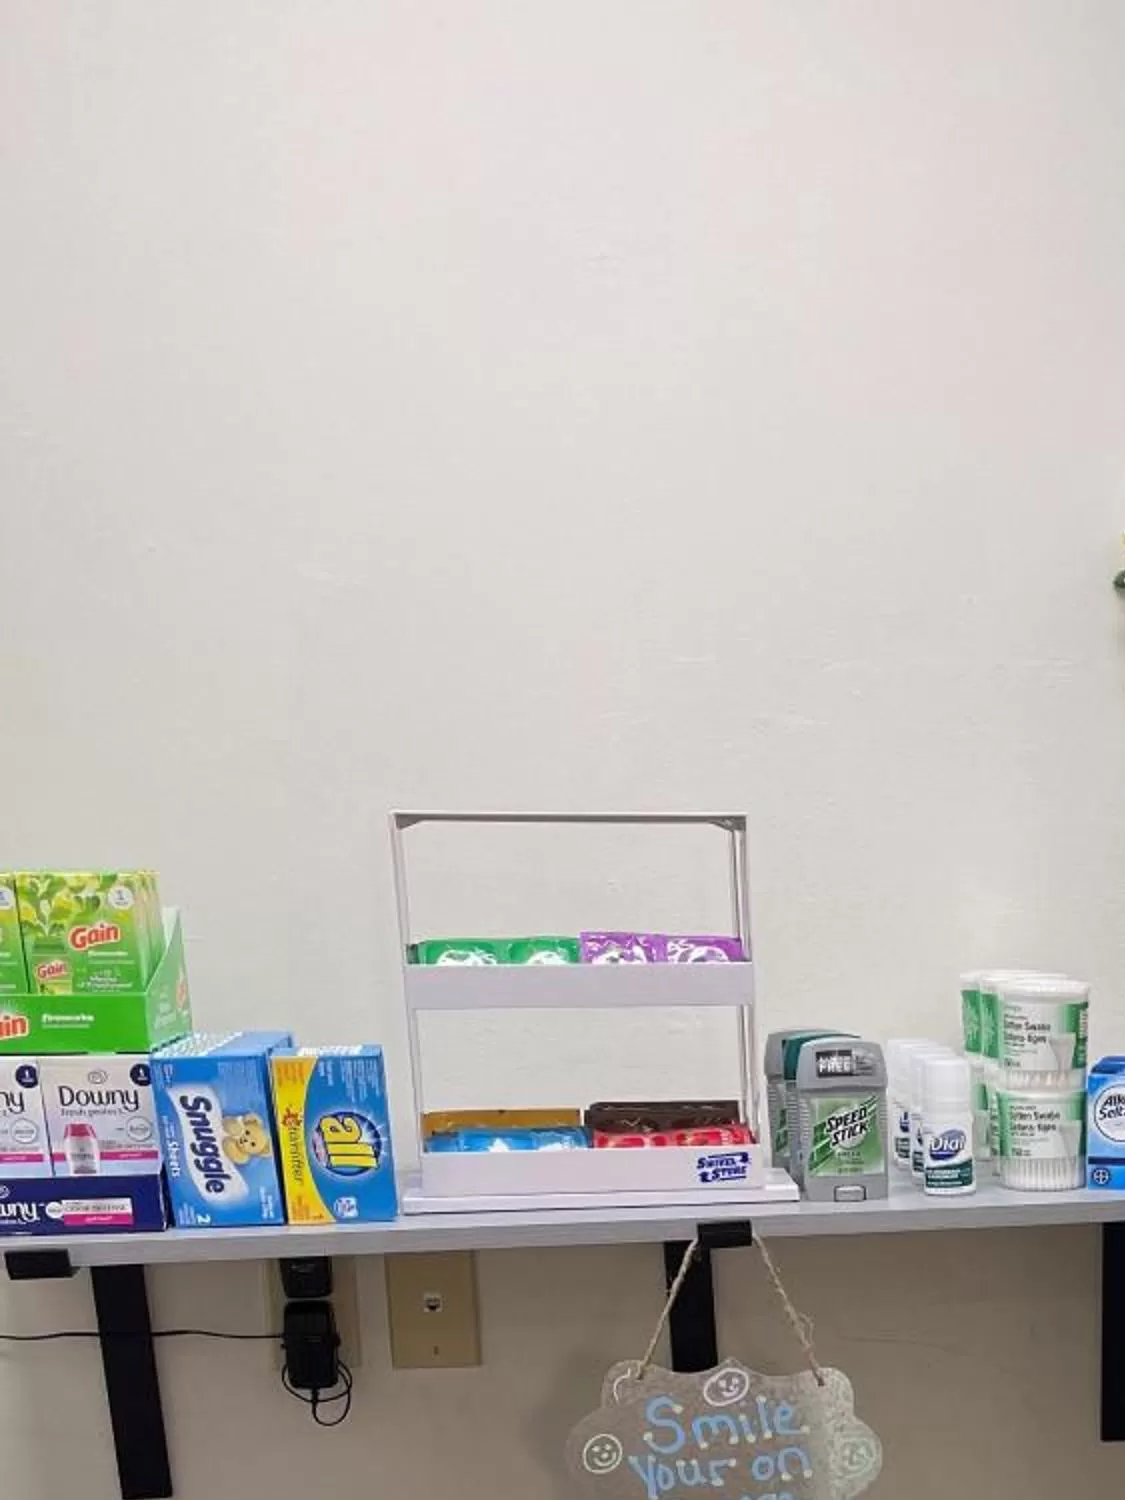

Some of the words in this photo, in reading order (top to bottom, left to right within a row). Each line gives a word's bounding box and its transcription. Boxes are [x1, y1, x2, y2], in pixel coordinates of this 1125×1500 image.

[69, 922, 120, 949] Gain
[59, 1086, 139, 1112] Downy
[826, 1106, 868, 1133] SPEED
[832, 1121, 868, 1146] STICK
[179, 1095, 234, 1195] Snuggle
[321, 1116, 379, 1168] all
[643, 1396, 811, 1454] Smile
[628, 1454, 737, 1500] Your
[751, 1447, 813, 1481] on
